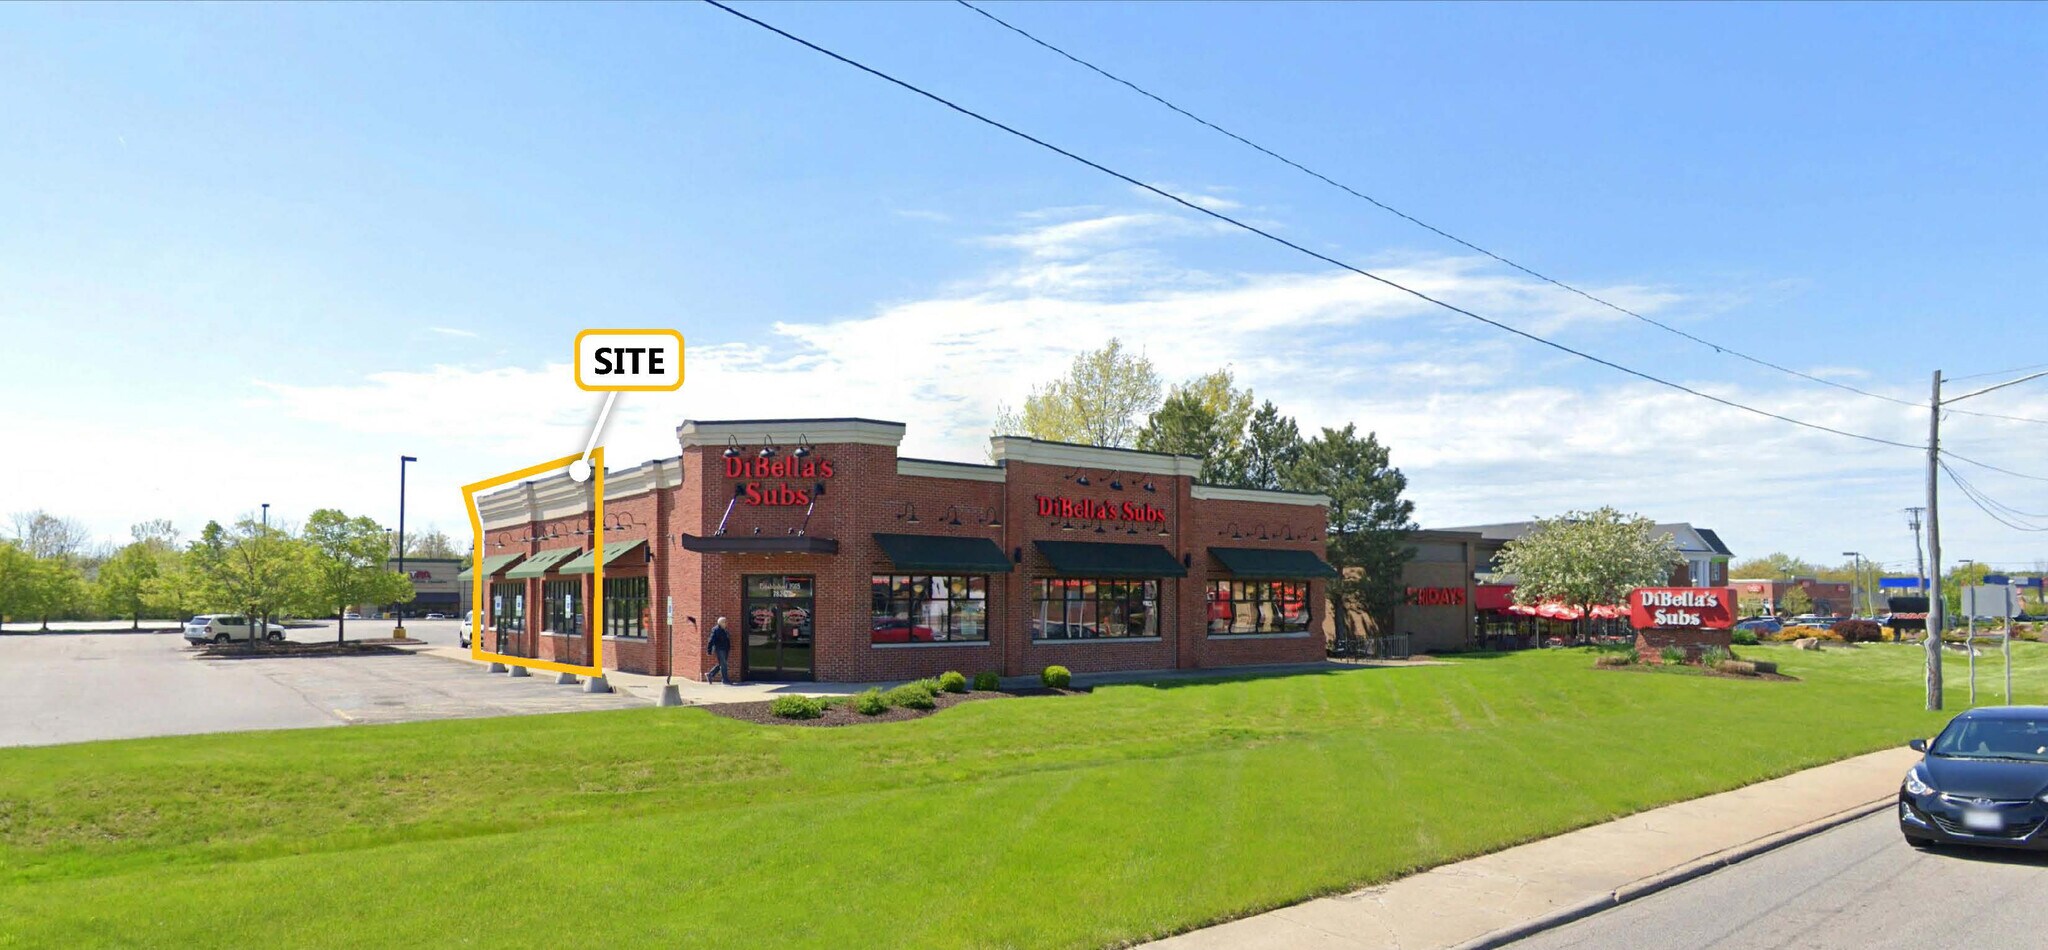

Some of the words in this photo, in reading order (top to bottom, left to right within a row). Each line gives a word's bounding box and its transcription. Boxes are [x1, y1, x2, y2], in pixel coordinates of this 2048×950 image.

[723, 455, 834, 479] DiBella's
[745, 481, 810, 507] Subs
[1035, 494, 1118, 519] DiBella's
[1121, 500, 1166, 522] Subs
[1640, 590, 1718, 607] DiBella's
[1653, 608, 1701, 626] Subs
